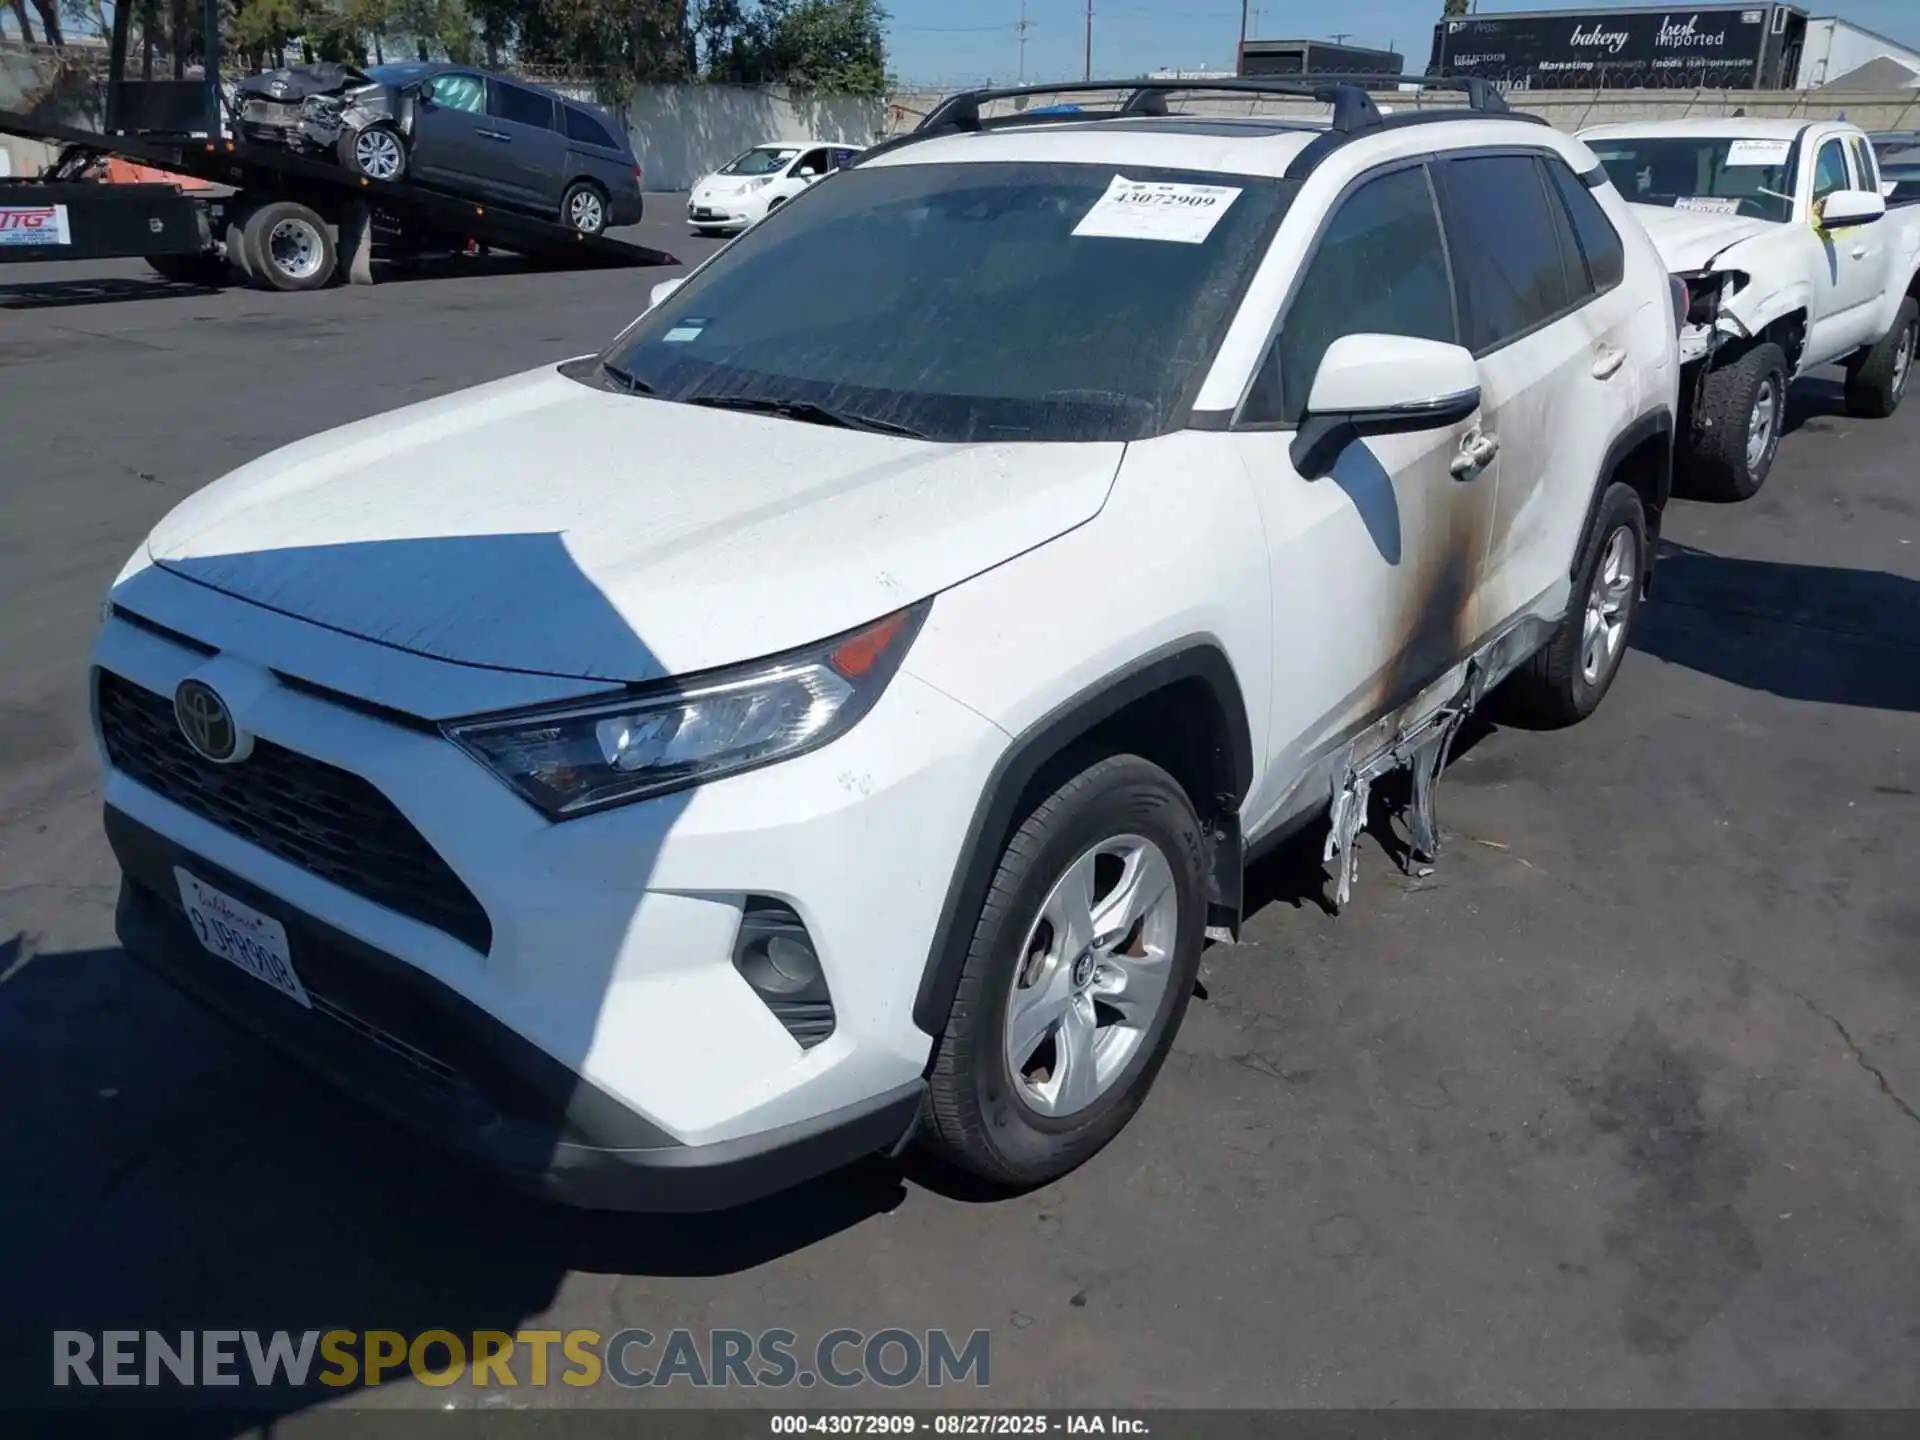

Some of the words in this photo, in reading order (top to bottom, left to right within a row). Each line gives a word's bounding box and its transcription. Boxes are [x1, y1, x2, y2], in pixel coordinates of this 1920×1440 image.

[1661, 14, 1698, 37] fresh
[1570, 24, 1629, 53] bakery
[1655, 31, 1725, 48] imported
[1539, 60, 1594, 71] Marketing
[1114, 191, 1217, 207] 43072909
